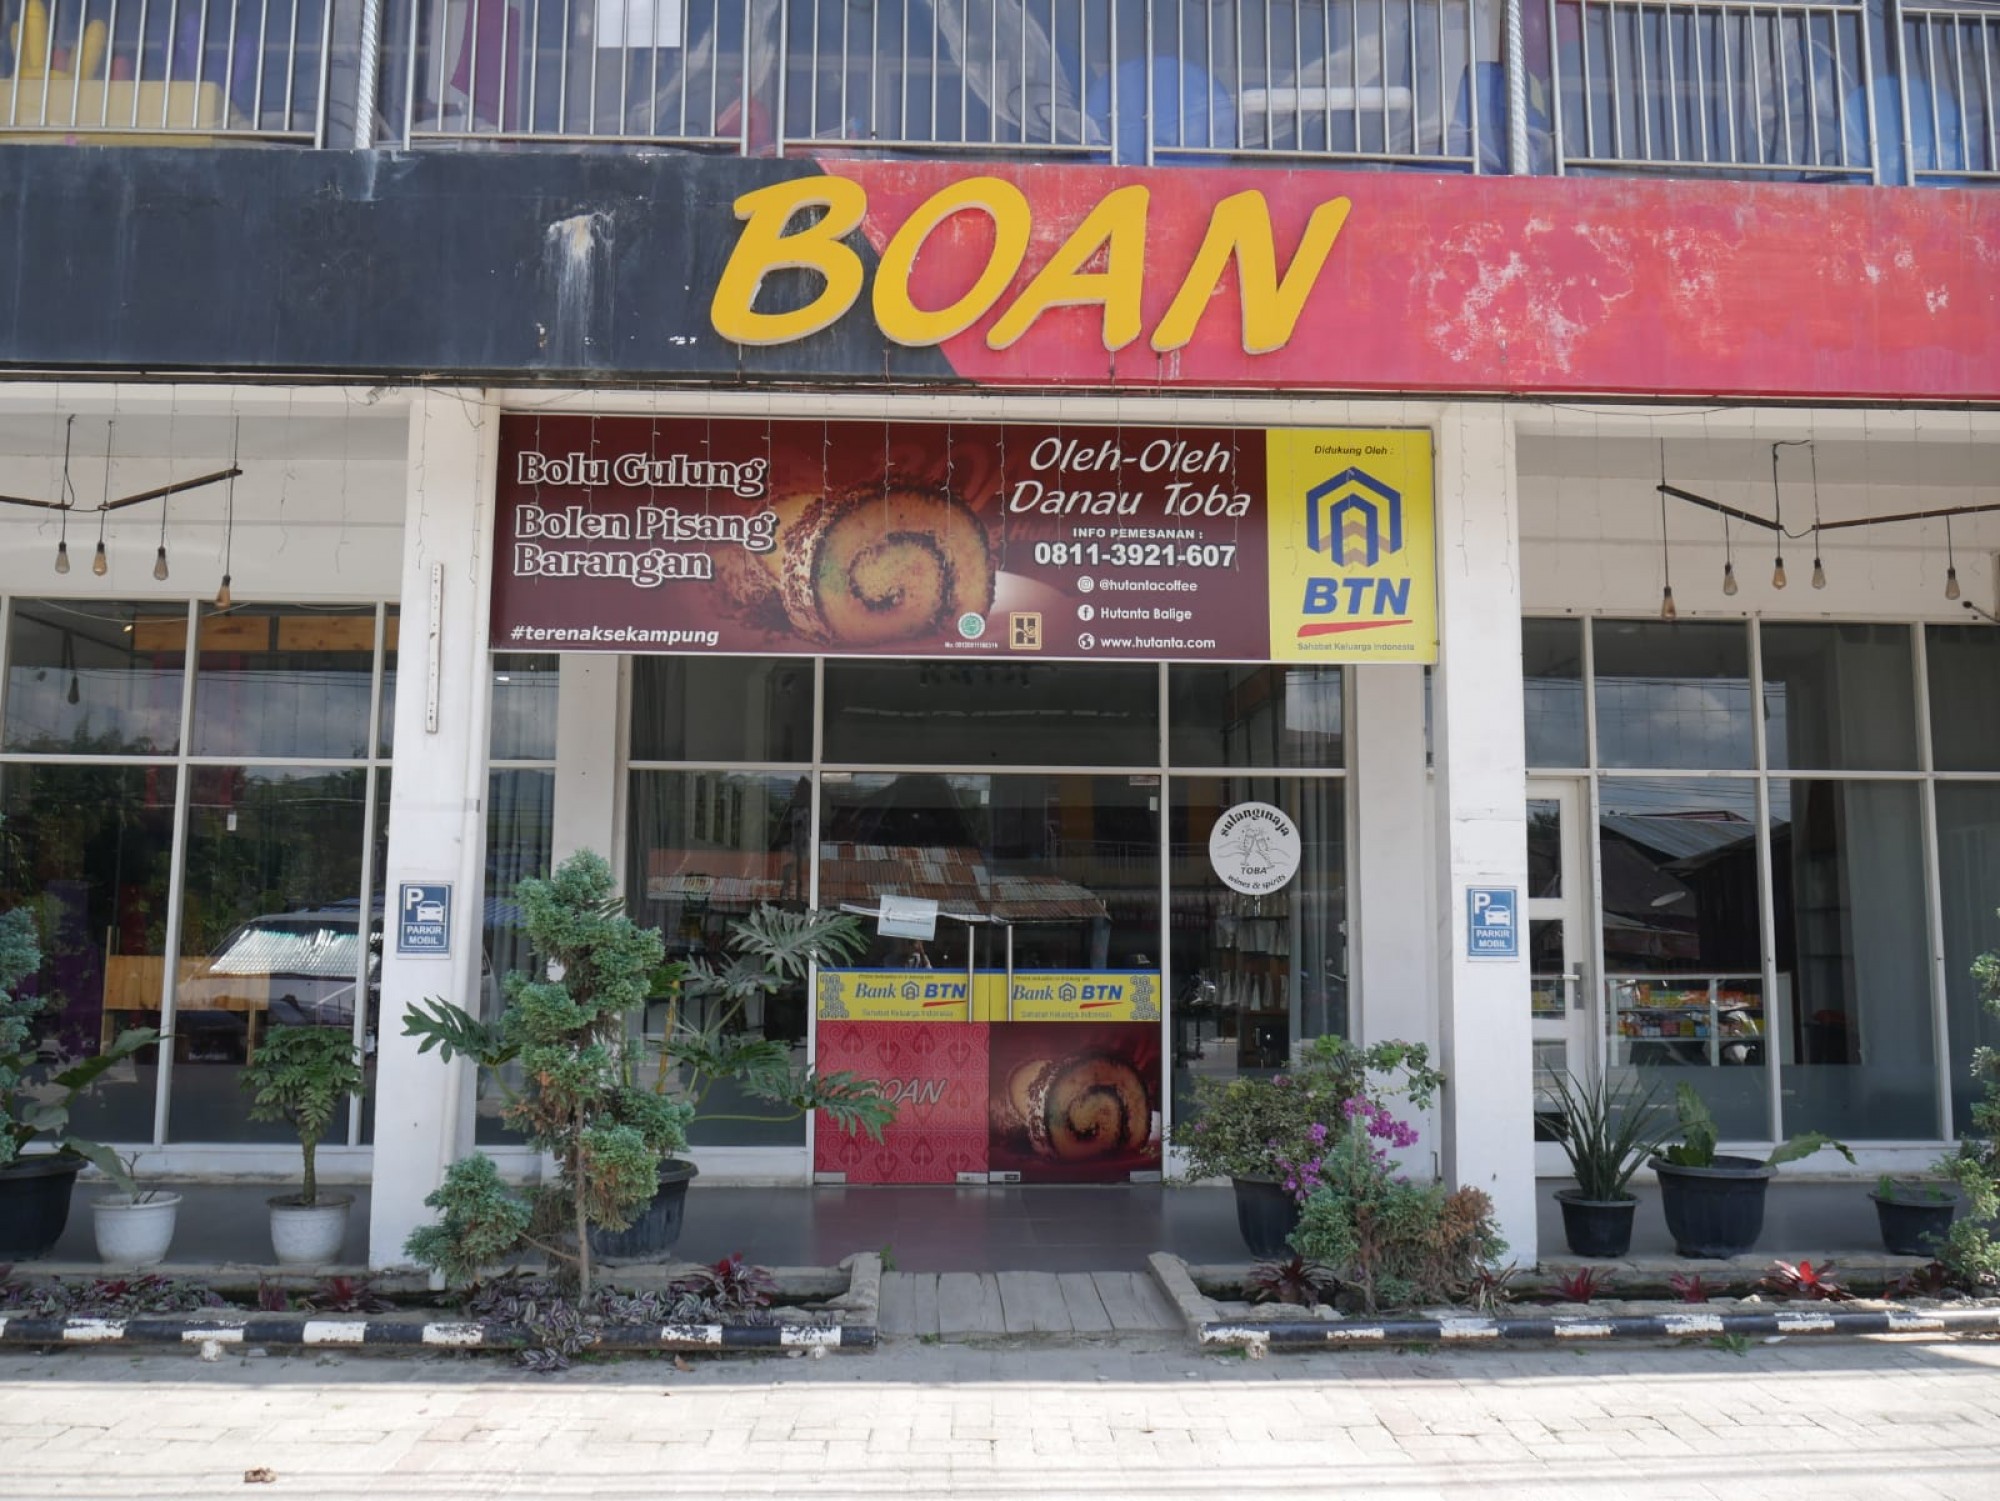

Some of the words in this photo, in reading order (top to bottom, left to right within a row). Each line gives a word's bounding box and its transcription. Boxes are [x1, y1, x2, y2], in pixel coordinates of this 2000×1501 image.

[711, 175, 1351, 355] BOAN
[1030, 437, 1231, 473] Oleh-Oleh
[1314, 446, 1362, 456] Didukung
[1365, 446, 1388, 455] Oleh
[518, 451, 609, 486] Bolu
[614, 452, 767, 497] Gulung
[1009, 480, 1144, 515] Danau
[1164, 482, 1252, 517] Toba
[515, 505, 631, 539] Bolen
[635, 506, 777, 551] Pisang
[1073, 527, 1106, 539] INFO
[1110, 528, 1196, 540] PEMESANAN
[1034, 542, 1237, 567] 0811-3921-607
[514, 543, 712, 588] Barangan
[1302, 577, 1411, 615] BTN
[1100, 607, 1150, 620] Hutanta
[1153, 608, 1193, 622] Balige
[510, 625, 720, 646] #terenaksekampung
[1100, 636, 1216, 649] www.hutanta.com
[1241, 867, 1268, 875] TOBA
[1228, 874, 1250, 889] wines
[1252, 882, 1260, 890] &
[406, 888, 424, 911] P
[1474, 892, 1491, 914] P
[407, 925, 442, 935] PARKIR
[1476, 929, 1511, 938] PARKIR
[408, 936, 440, 945] MOBIL
[1478, 939, 1507, 948] MOBIL
[855, 982, 896, 999] Bank
[924, 983, 967, 999] BTN
[1013, 984, 1055, 1001] Bank
[1080, 985, 1124, 1000] BTN
